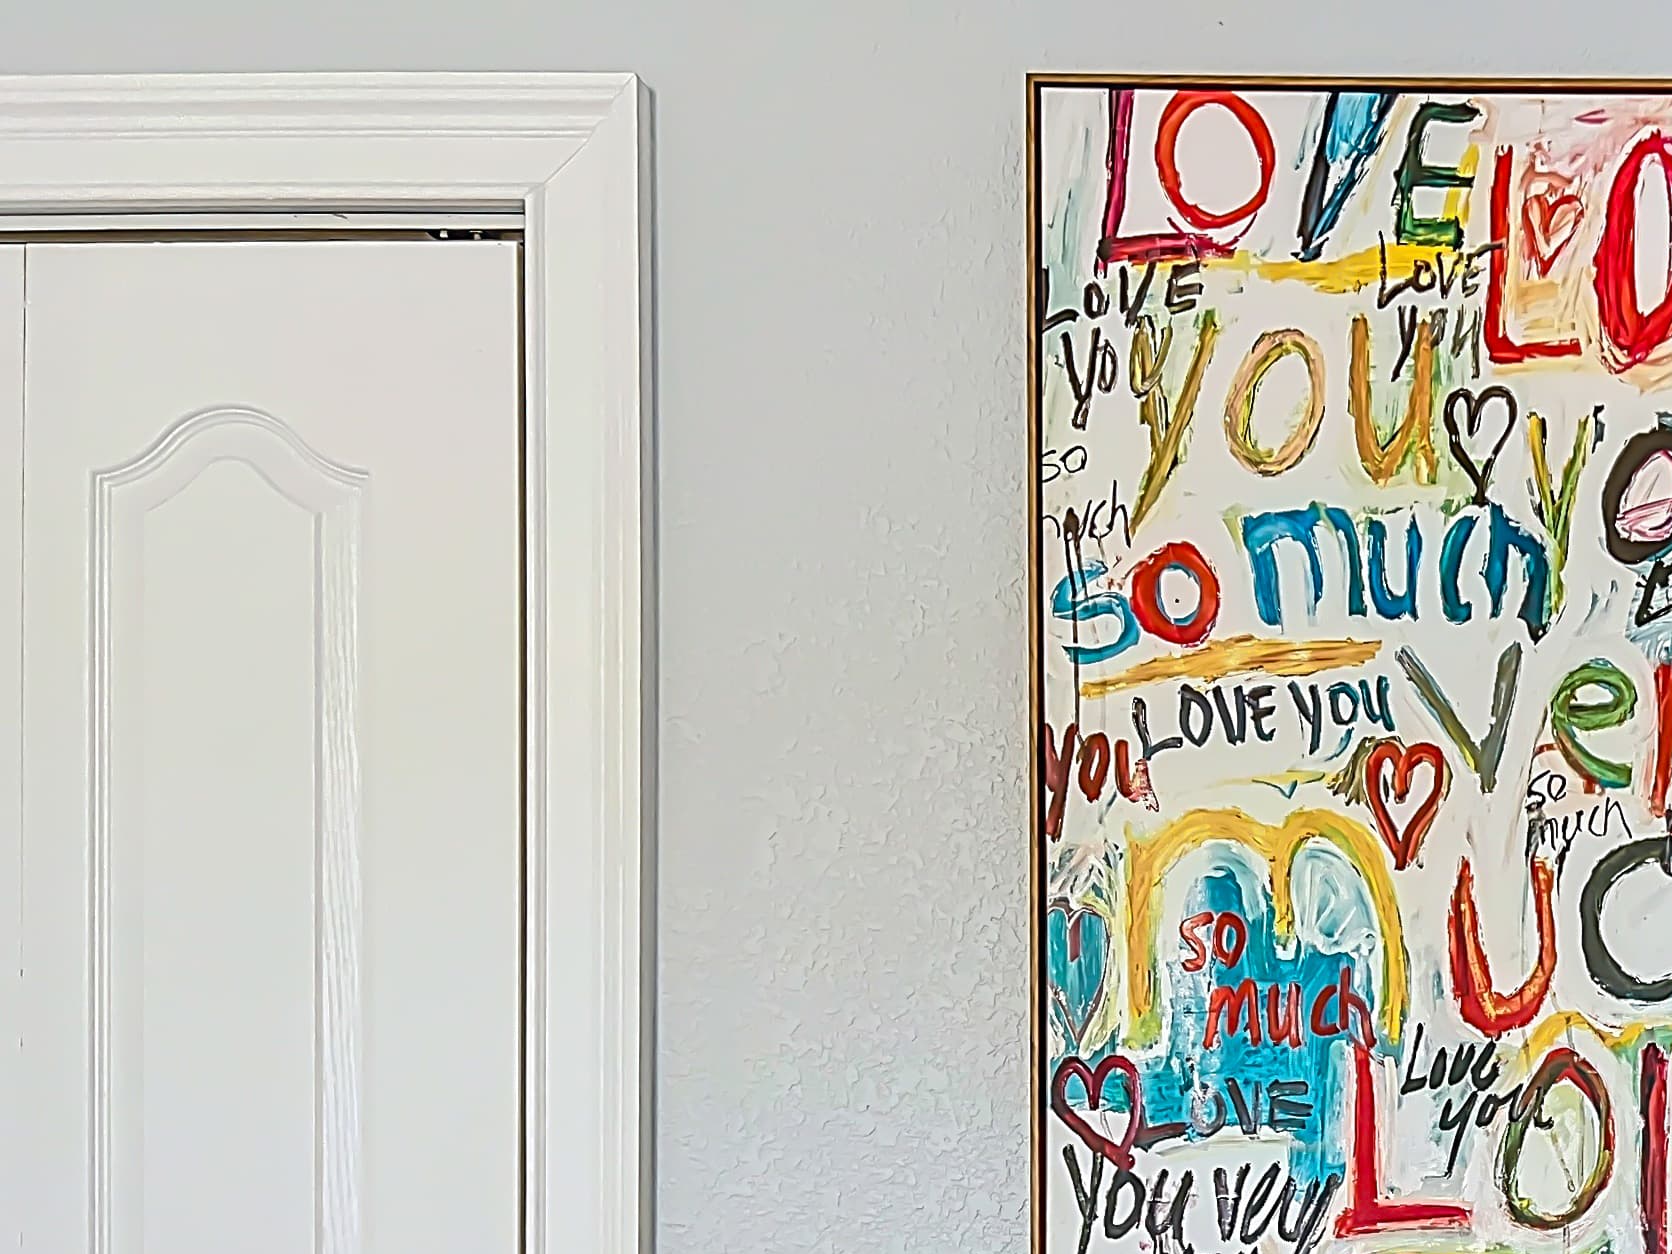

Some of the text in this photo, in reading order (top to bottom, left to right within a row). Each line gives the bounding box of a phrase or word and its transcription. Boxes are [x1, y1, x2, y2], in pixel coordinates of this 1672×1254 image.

[1097, 90, 1481, 262] LOVE
[1042, 261, 1205, 334] LOVE
[1132, 683, 1277, 760] LOVE
